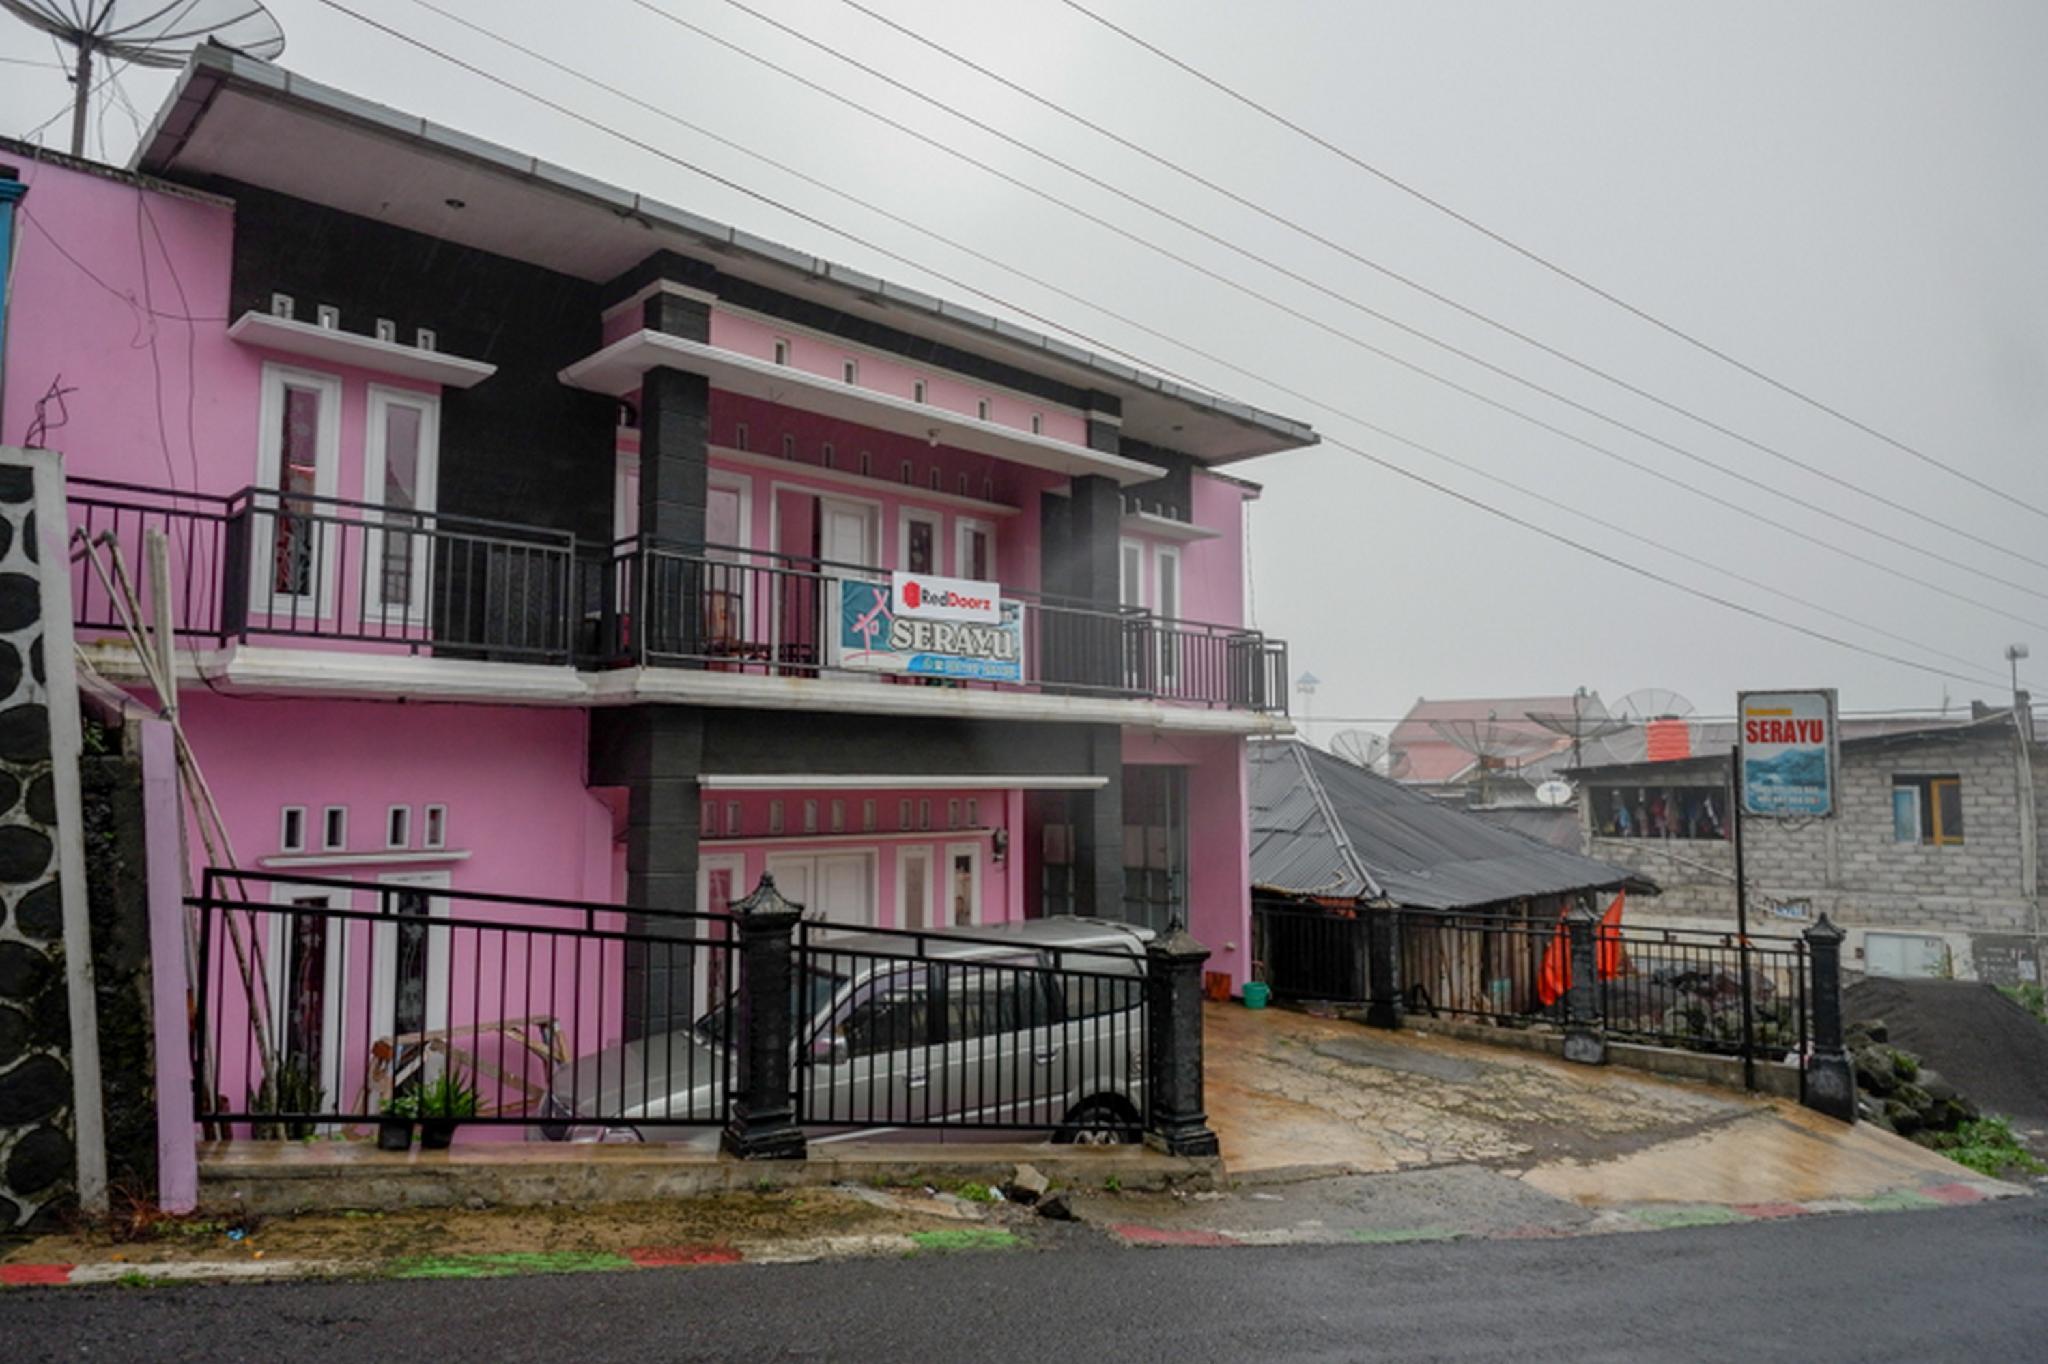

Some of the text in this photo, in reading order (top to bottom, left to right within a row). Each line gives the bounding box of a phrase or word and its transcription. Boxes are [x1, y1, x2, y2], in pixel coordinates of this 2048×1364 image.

[921, 589, 991, 610] RedDoorz
[891, 617, 1016, 660] SERAYU
[1746, 719, 1823, 744] SERAYU
